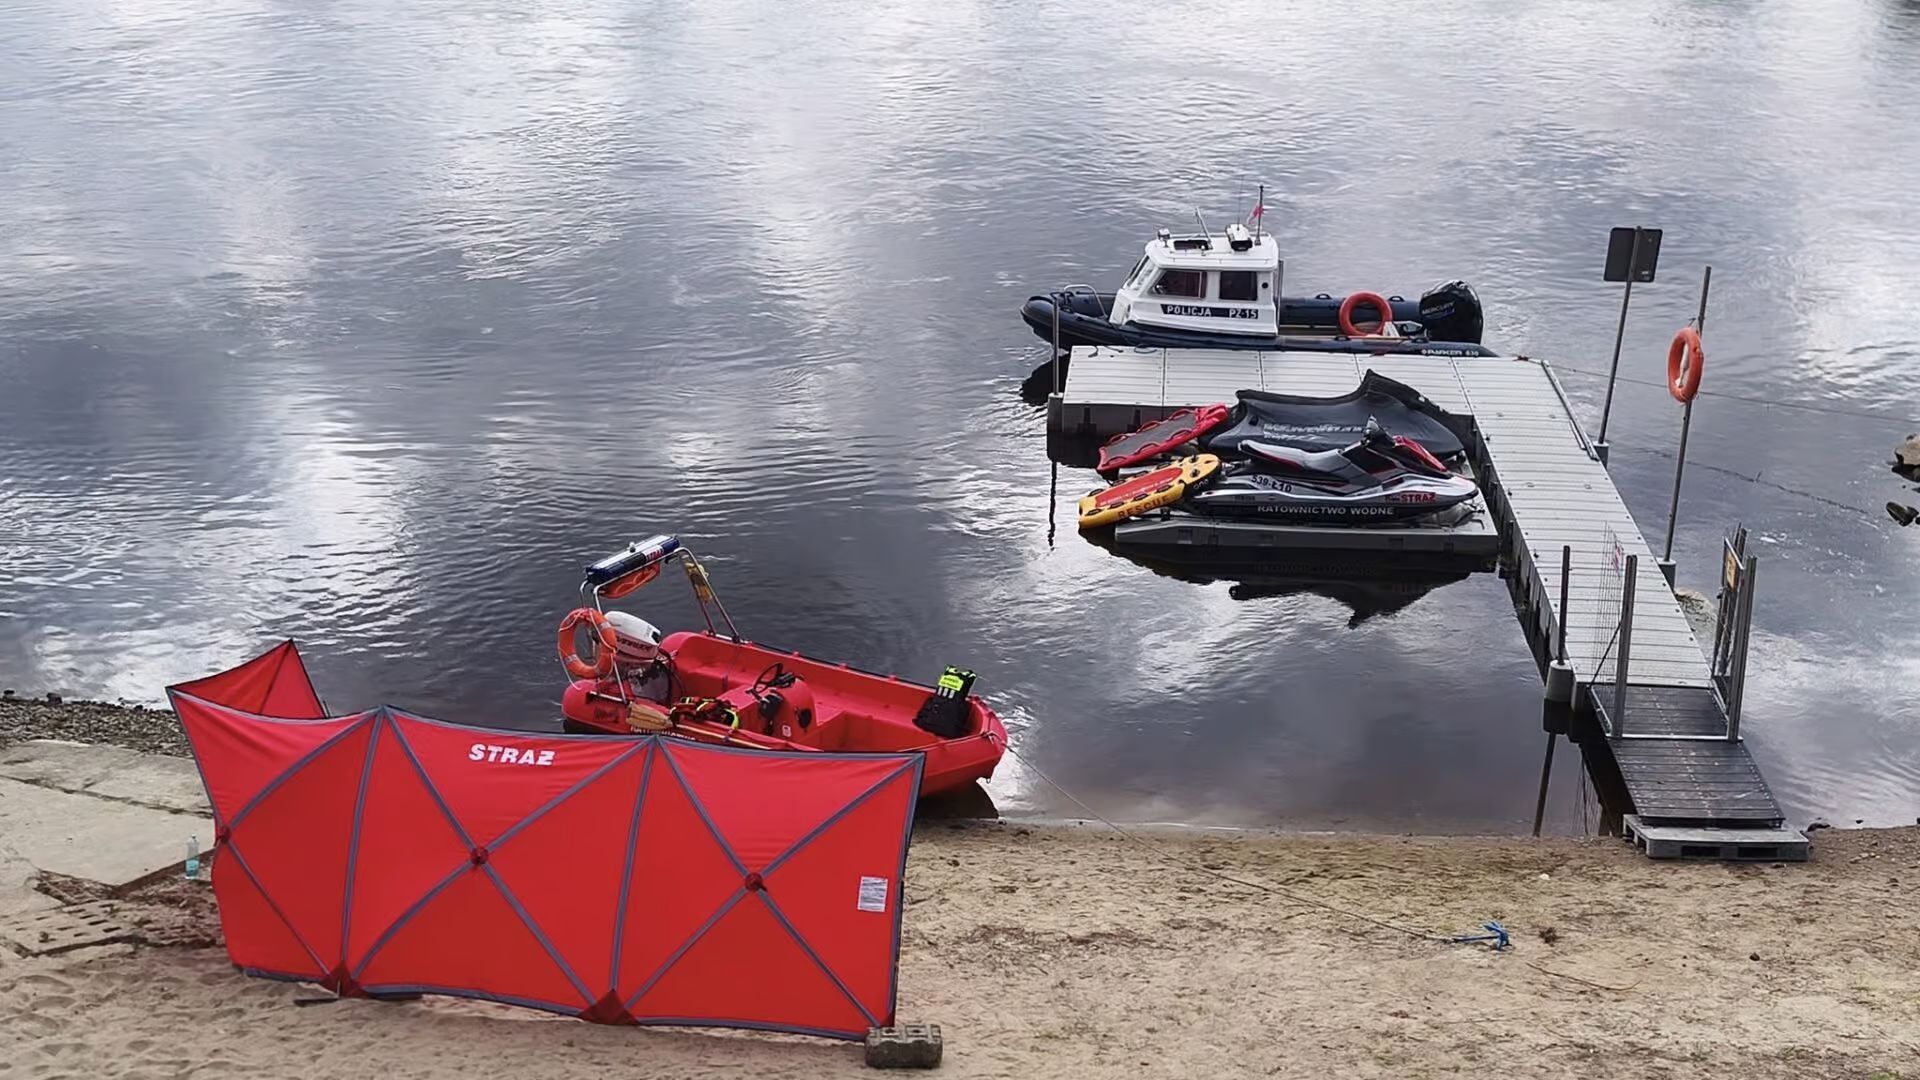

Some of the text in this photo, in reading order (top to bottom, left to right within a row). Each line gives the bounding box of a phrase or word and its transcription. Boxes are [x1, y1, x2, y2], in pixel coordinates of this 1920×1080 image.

[1166, 305, 1257, 319] POLICJA PZ-15
[1117, 494, 1170, 519] RESCUE
[1257, 504, 1395, 516] RATOWNICTWO WODNE
